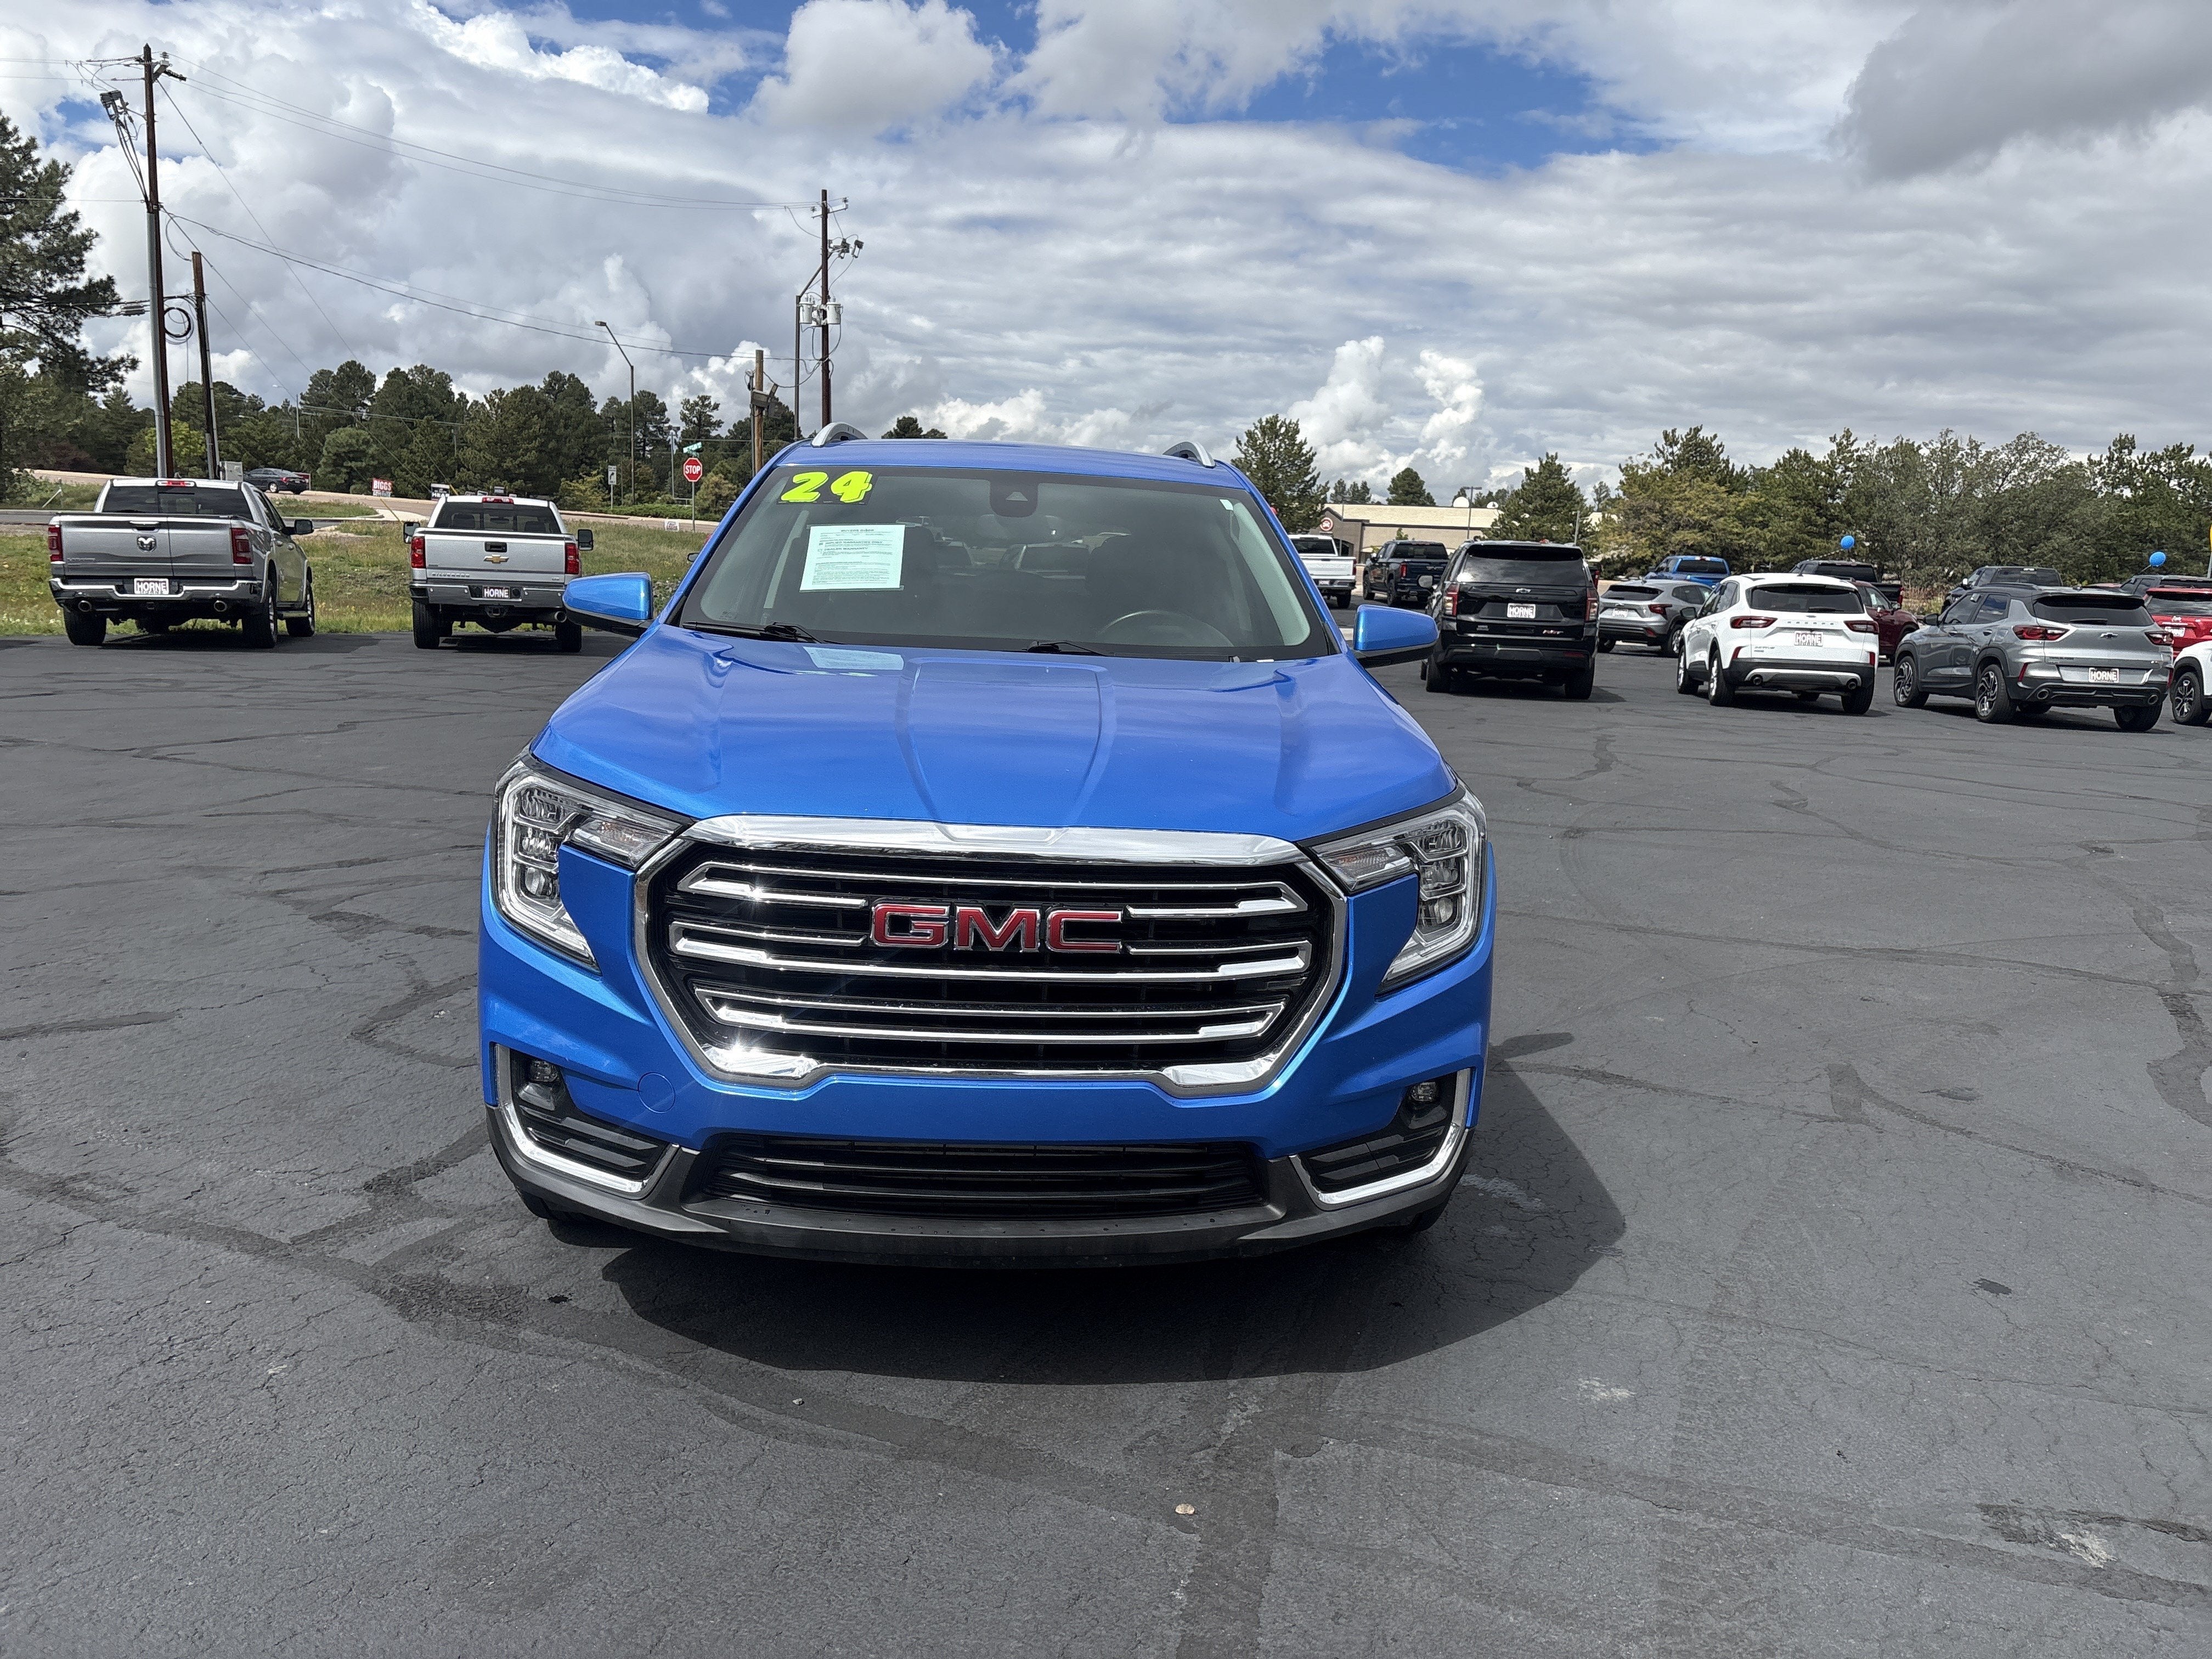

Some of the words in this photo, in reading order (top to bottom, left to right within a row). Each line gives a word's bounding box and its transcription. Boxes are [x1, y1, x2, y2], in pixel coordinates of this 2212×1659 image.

[685, 465, 701, 475] STOP
[374, 480, 392, 491] BIGGS
[781, 471, 873, 503] 24
[137, 582, 167, 591] HORNE
[484, 588, 509, 598] HORNE
[1509, 606, 1534, 615] HORNE
[1797, 634, 1822, 643] HORNE
[2090, 670, 2117, 680] HORNE
[871, 904, 1122, 953] GMC
